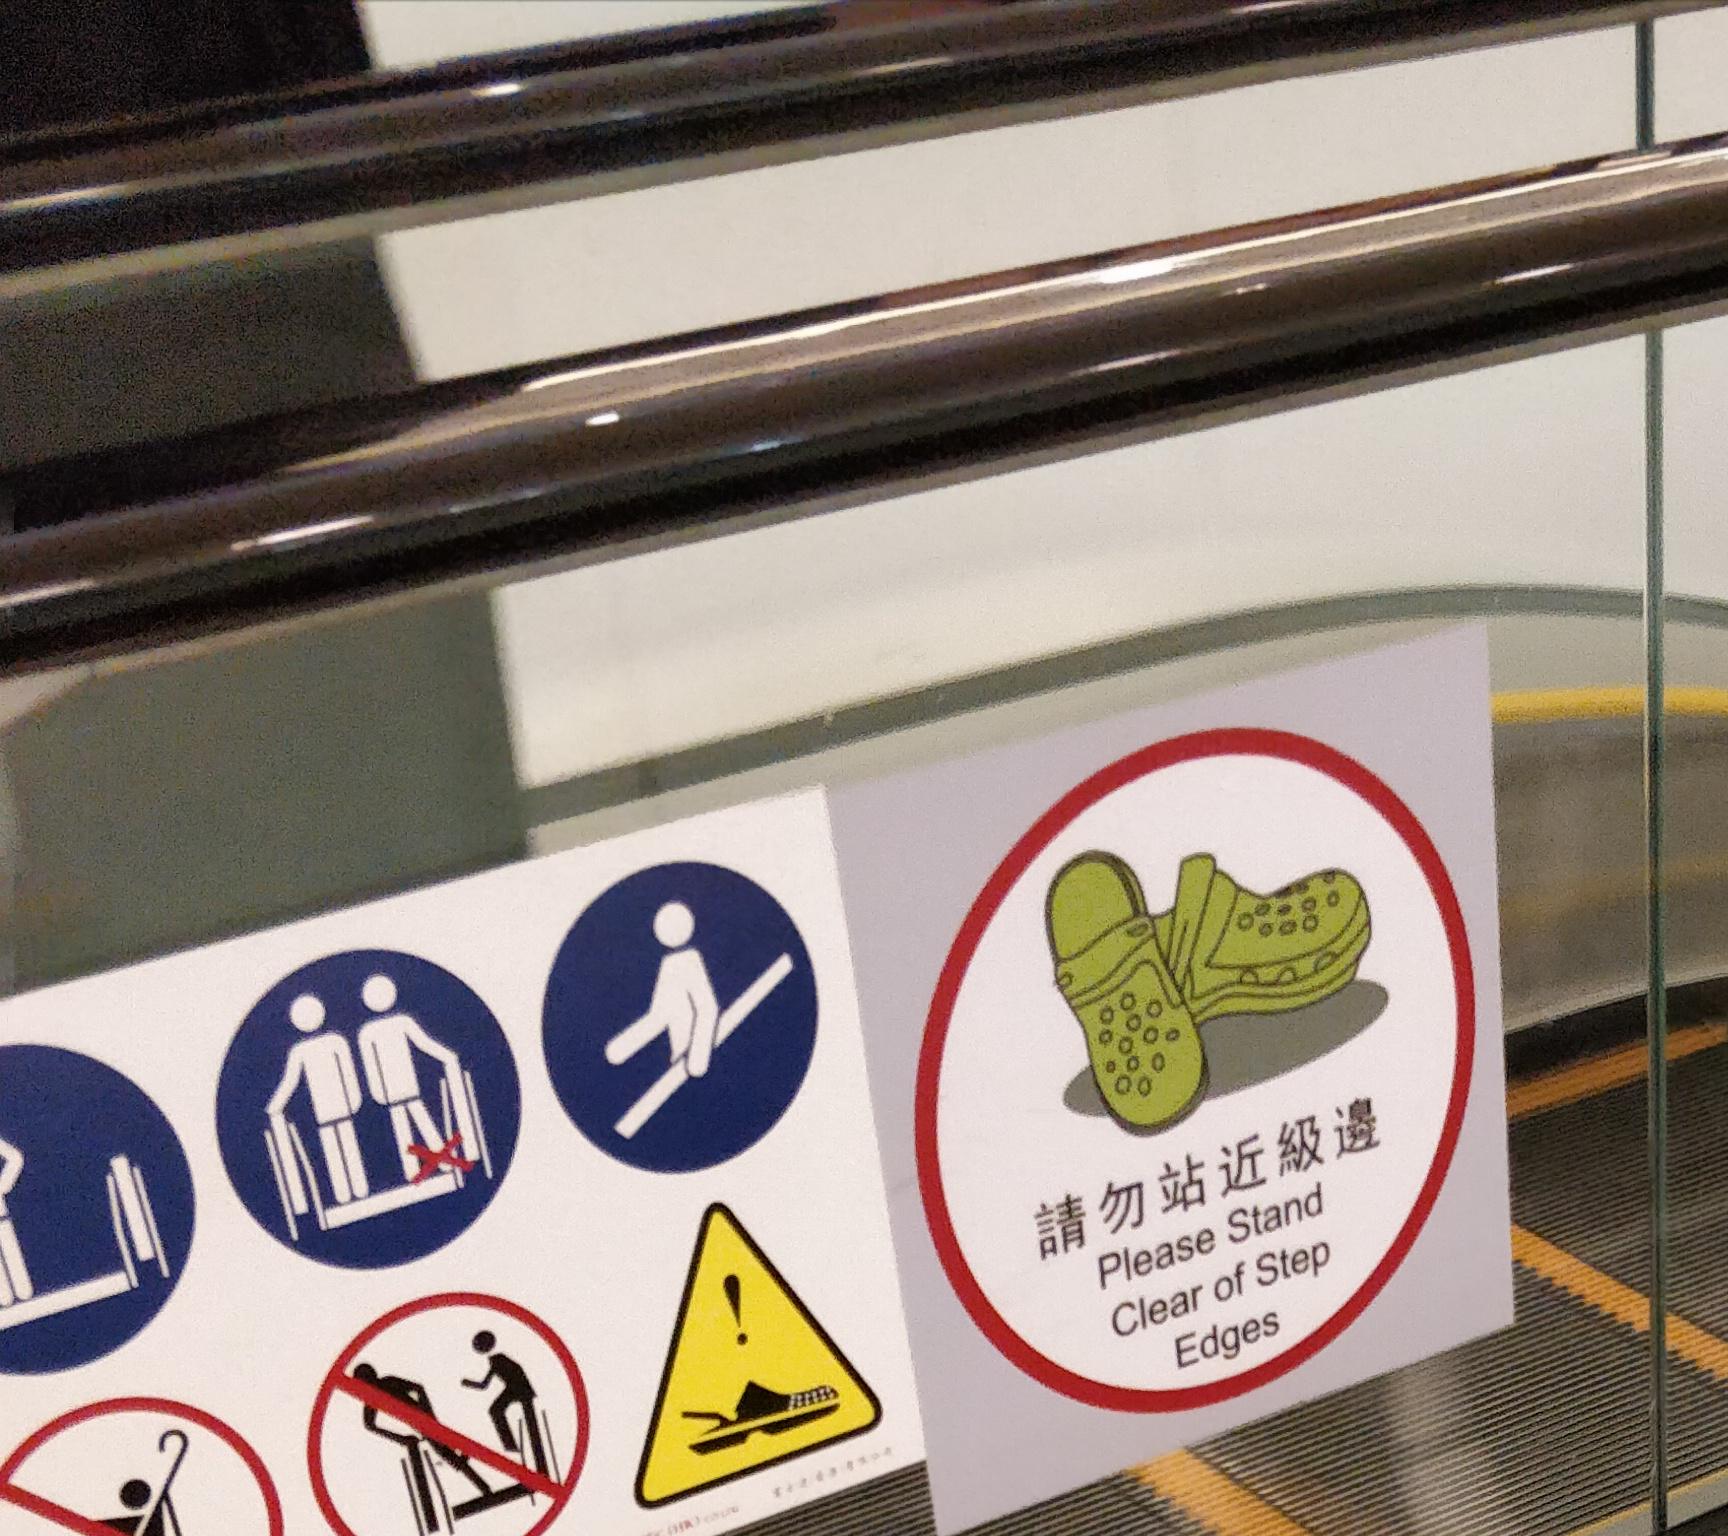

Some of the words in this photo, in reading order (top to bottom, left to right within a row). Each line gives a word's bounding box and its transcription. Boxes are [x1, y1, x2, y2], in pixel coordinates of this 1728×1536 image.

[1034, 1097, 1381, 1260] 請勿站近級邊
[1099, 1225, 1216, 1289] Please
[1227, 1182, 1324, 1244] Stand
[1111, 1284, 1205, 1337] Clear
[1213, 1262, 1246, 1302] of
[1256, 1239, 1331, 1288] Step
[1174, 1311, 1280, 1368] Edges
